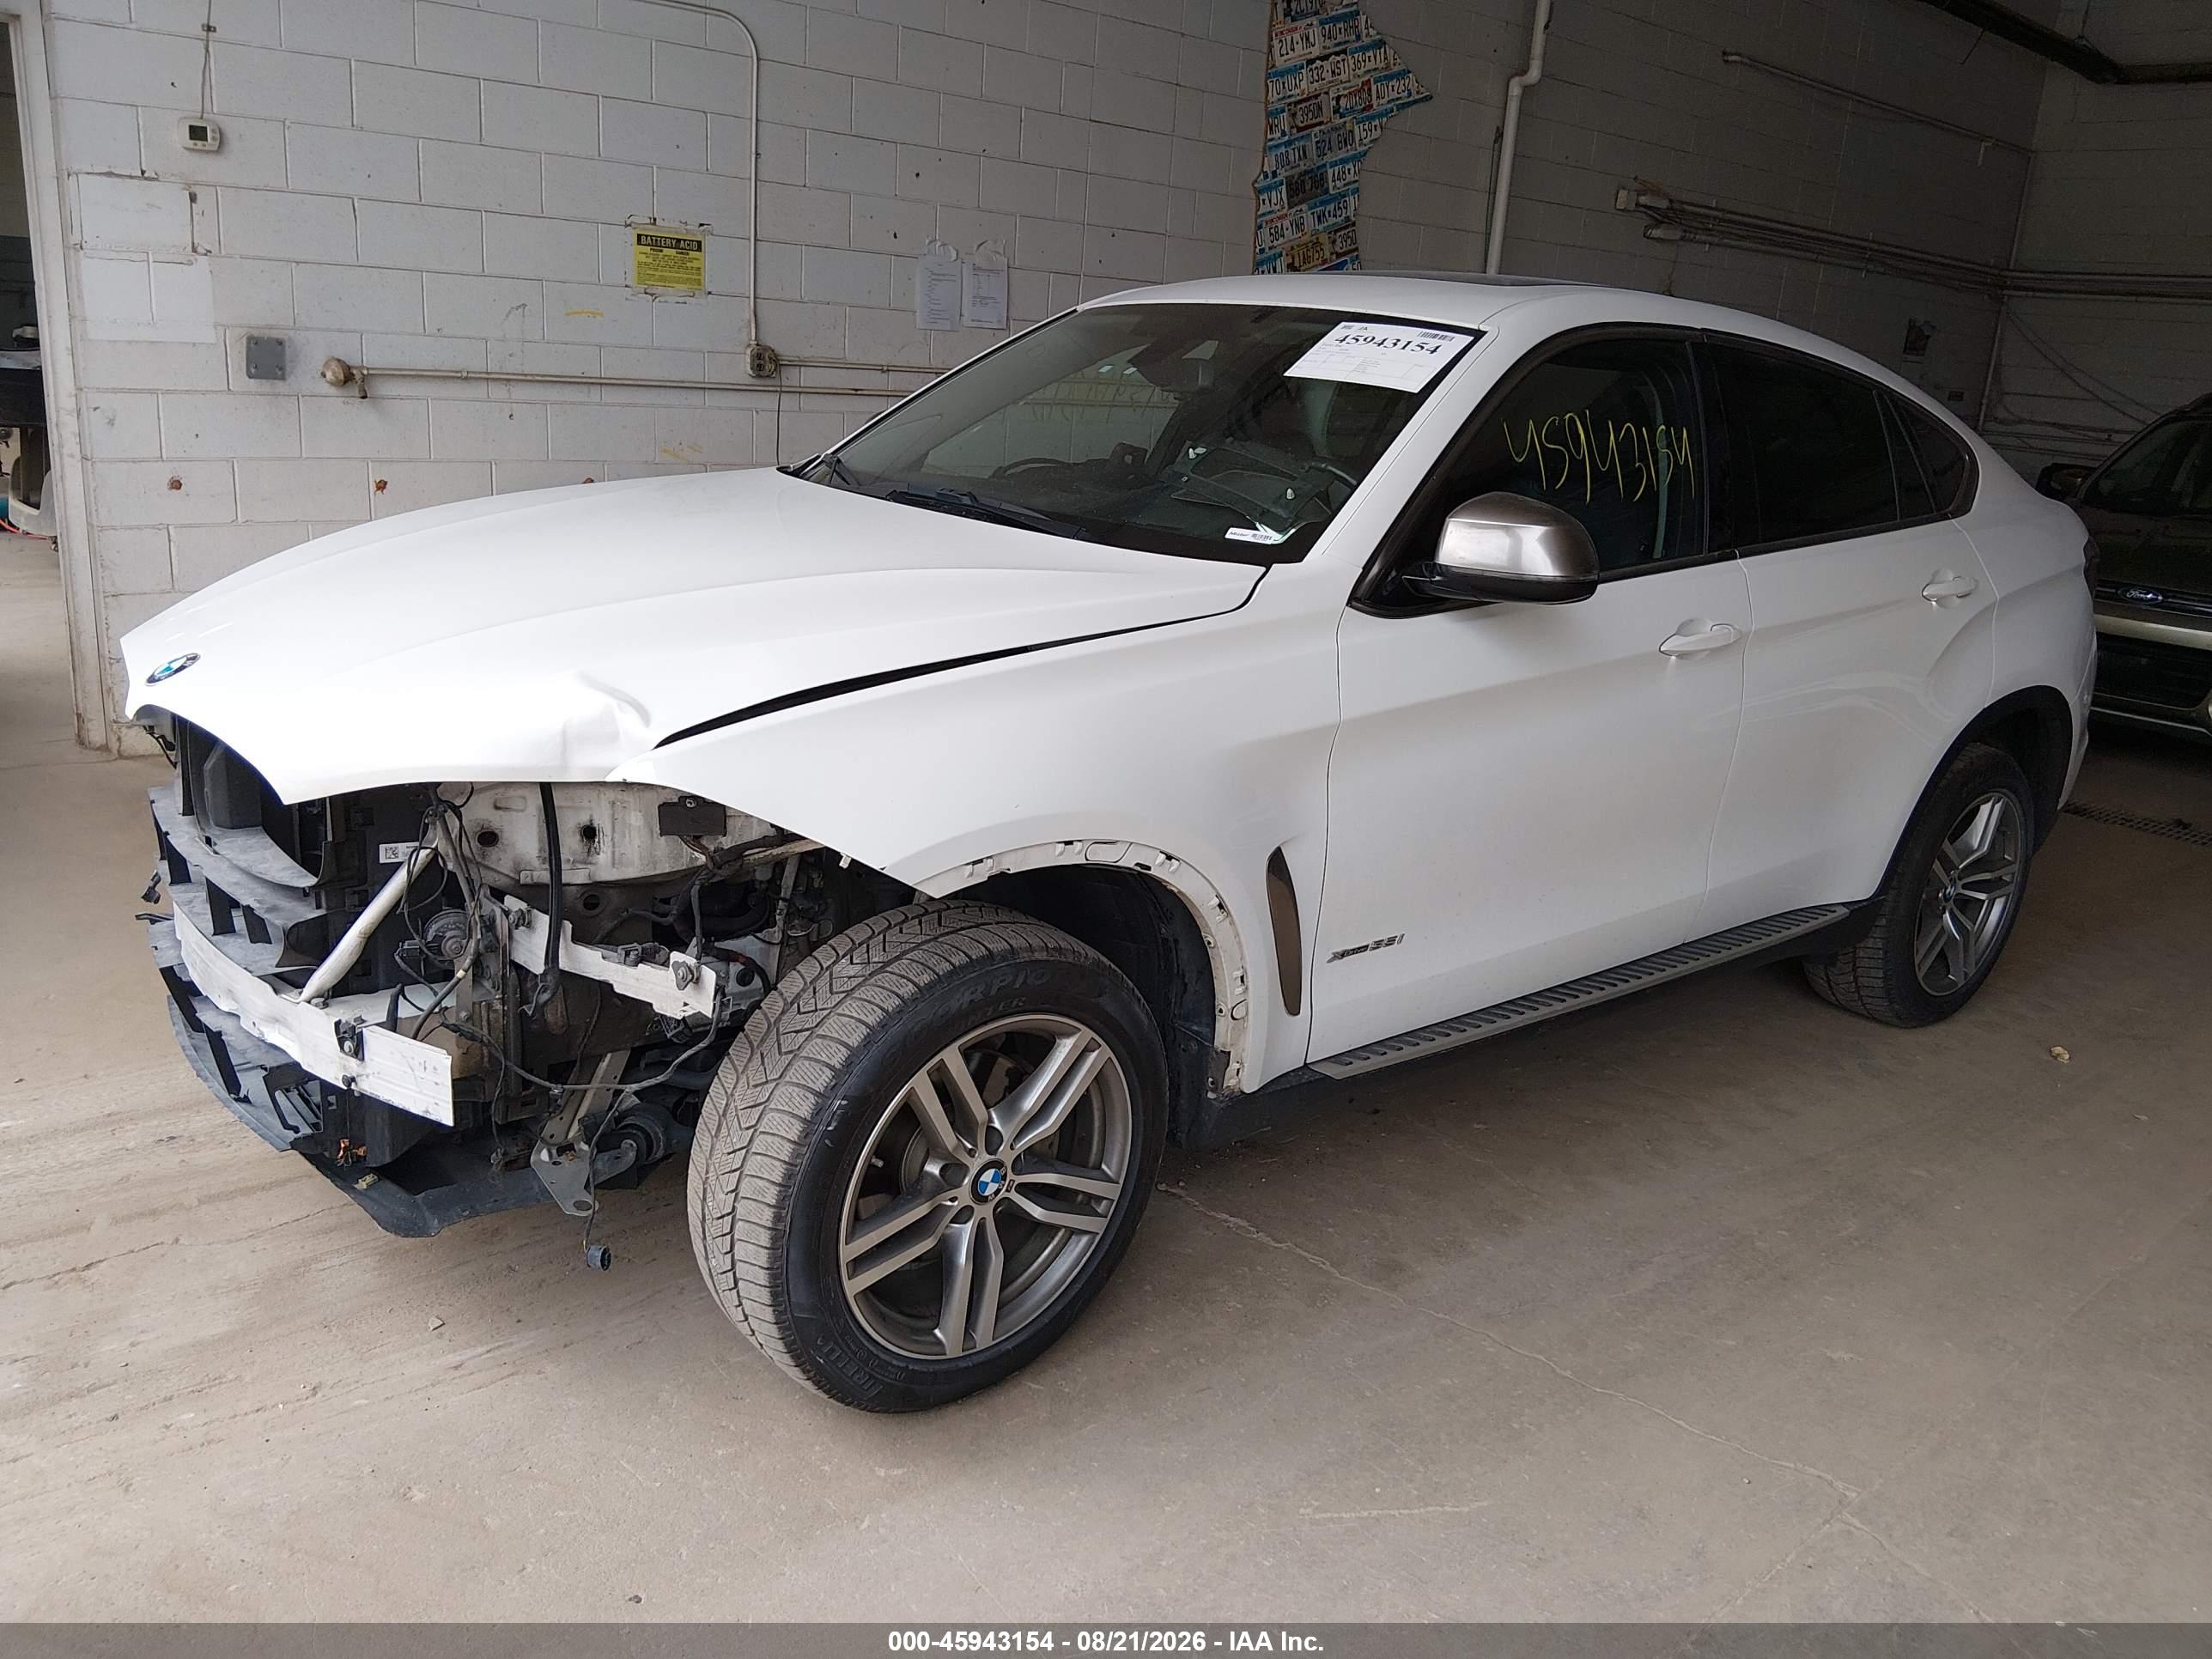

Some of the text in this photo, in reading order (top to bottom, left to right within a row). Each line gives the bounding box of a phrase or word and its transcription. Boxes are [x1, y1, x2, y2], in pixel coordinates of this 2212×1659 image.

[641, 235, 698, 250] BATTERY ACID
[1334, 334, 1442, 354] 45943154
[1504, 409, 1695, 505] 45943154
